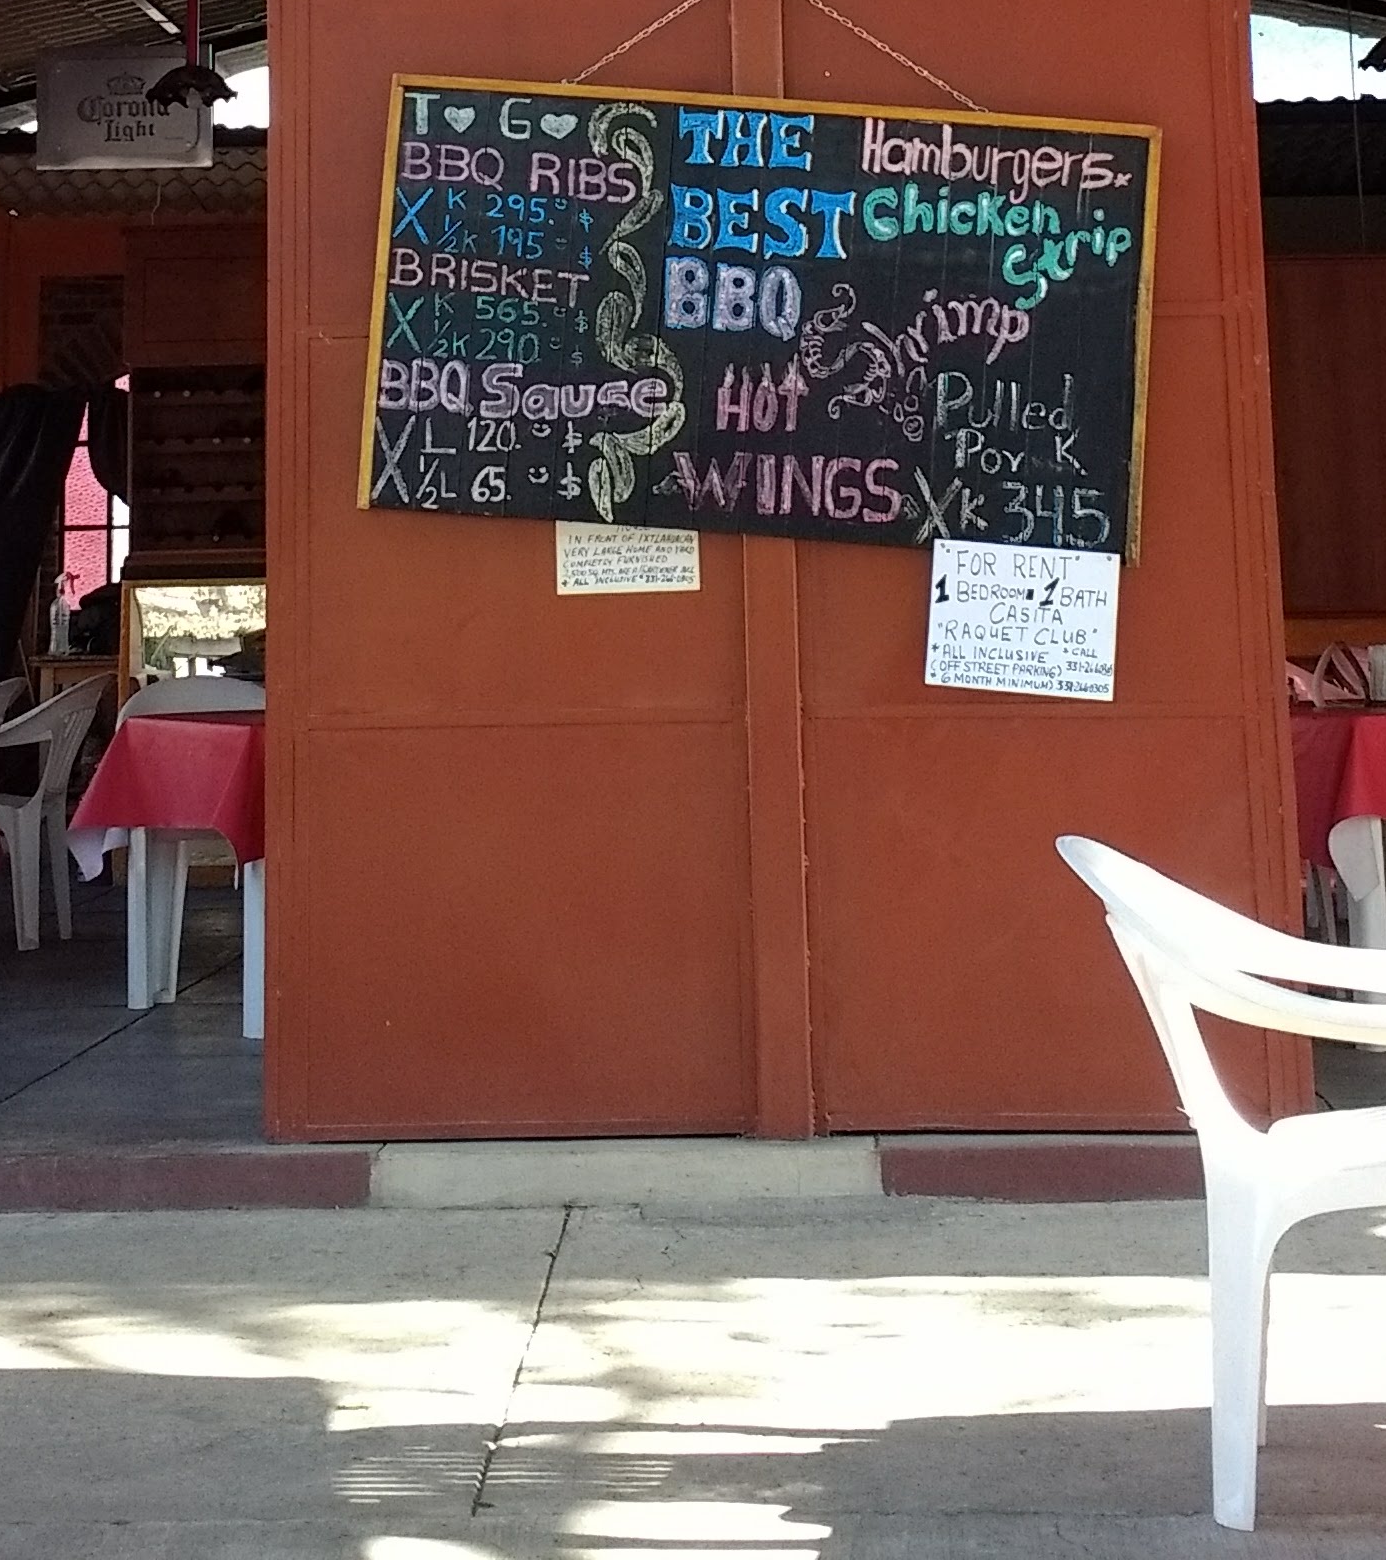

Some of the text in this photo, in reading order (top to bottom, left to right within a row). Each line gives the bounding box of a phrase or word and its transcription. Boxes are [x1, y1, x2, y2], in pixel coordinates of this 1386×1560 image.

[104, 118, 155, 142] Light
[679, 107, 814, 172] THE
[400, 141, 637, 204] BBQ RIBS
[667, 182, 857, 260] BEST
[490, 225, 544, 260] 195
[1002, 208, 1133, 311] Strip
[389, 248, 590, 308] BRISKET
[664, 257, 801, 342] BBQ
[378, 358, 474, 417] BBQ
[936, 371, 1075, 432] Pulled
[420, 416, 457, 454] L
[673, 451, 902, 523] WINGS
[1001, 481, 1111, 548] 345
[564, 547, 590, 558] VERY
[621, 534, 635, 543] OF
[617, 555, 668, 565] FURNISHED
[935, 574, 949, 603] 1
[1039, 577, 1060, 606] 1
[1060, 587, 1107, 608] BATH
[990, 602, 1063, 625] CASITA
[942, 644, 1049, 663] ALL INCLUSIVE
[964, 661, 1009, 675] STREET
[954, 673, 992, 685] MONTH
